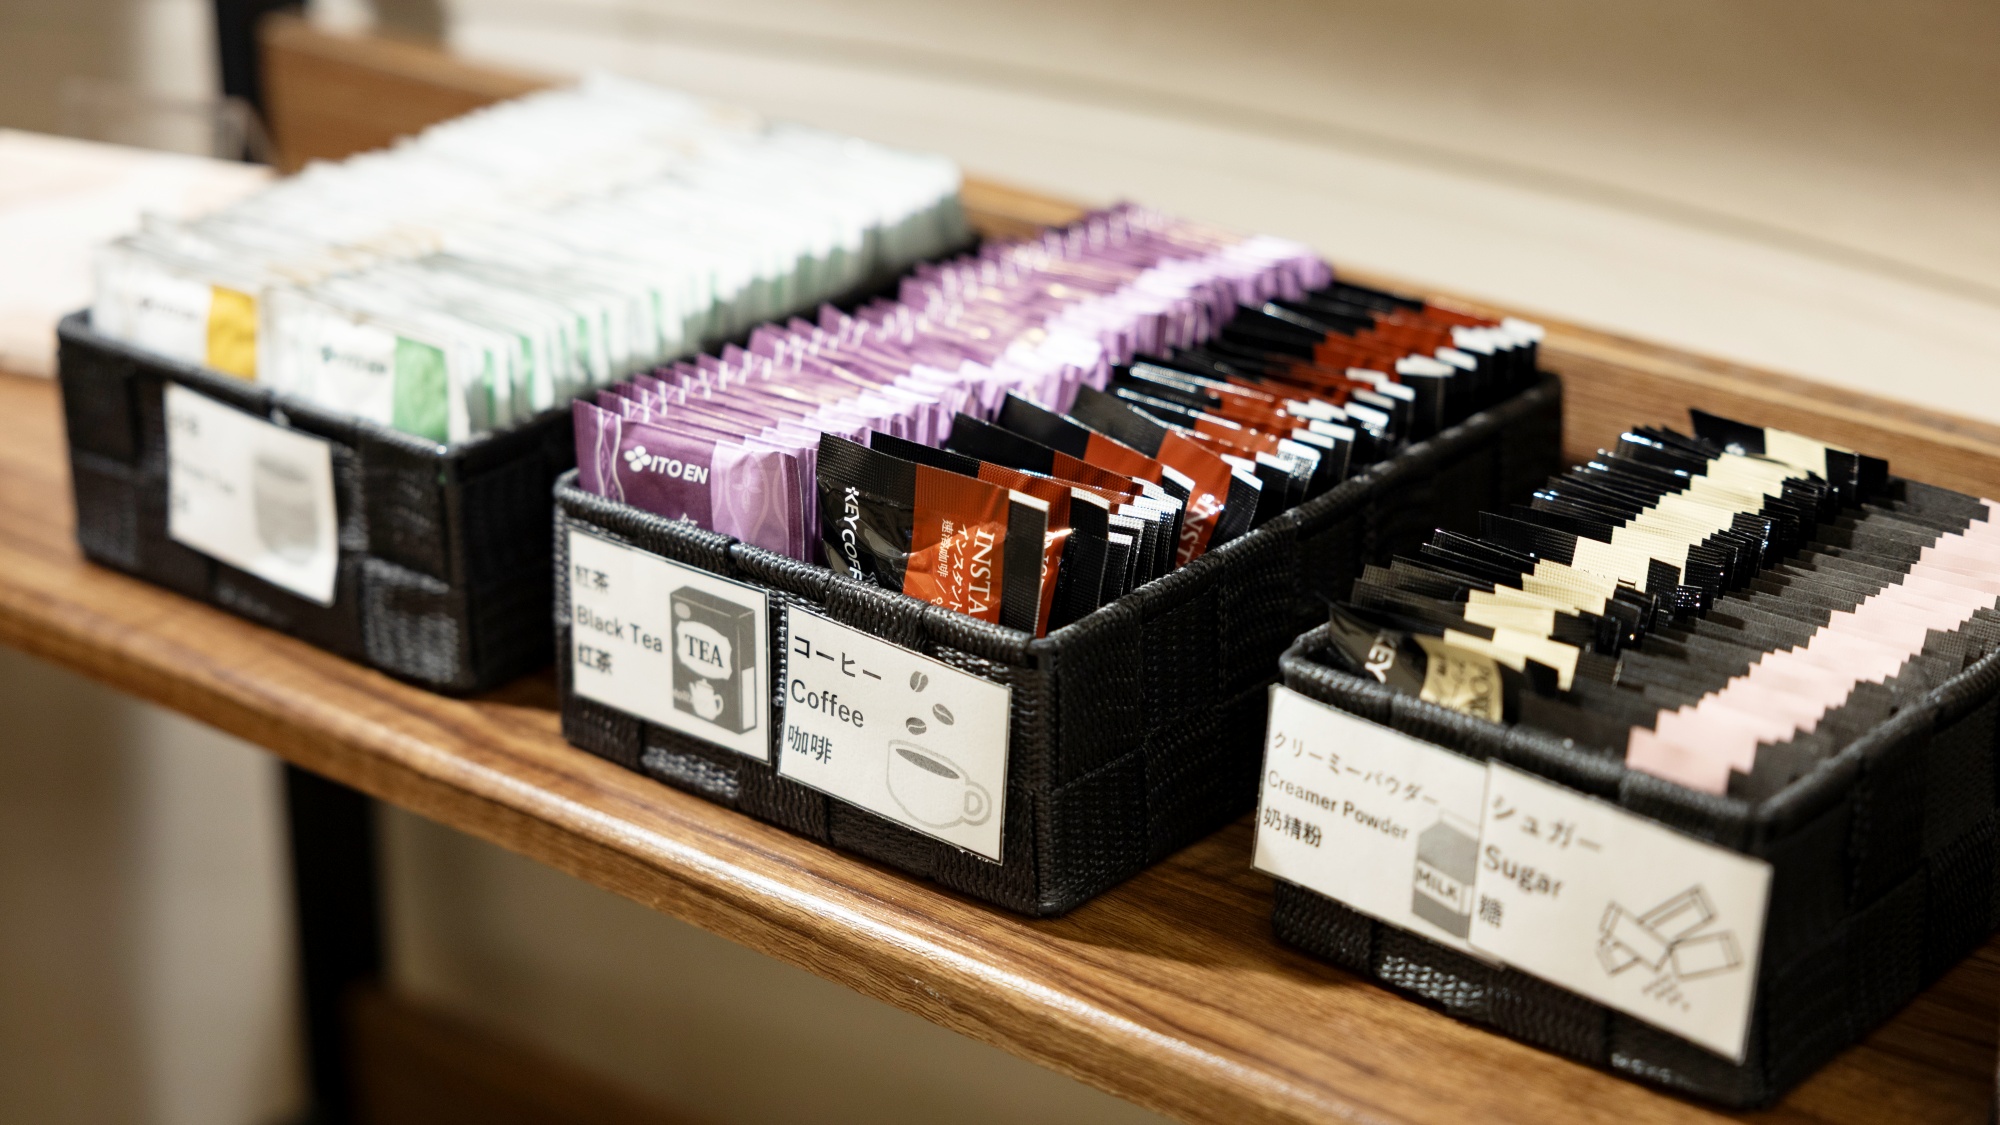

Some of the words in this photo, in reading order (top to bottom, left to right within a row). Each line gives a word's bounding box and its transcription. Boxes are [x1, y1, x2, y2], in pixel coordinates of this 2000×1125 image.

[650, 455, 682, 478] ITO
[682, 464, 709, 485] EN
[968, 528, 995, 617] INSTA
[577, 605, 624, 640] Black
[630, 623, 663, 653] Tea
[685, 634, 724, 668] TEA
[794, 635, 882, 680] コーヒー
[791, 679, 864, 728] Coffee
[788, 725, 833, 764] 咖啡
[1264, 806, 1322, 848] 奶精粉
[1268, 770, 1337, 813] Creamer
[1343, 801, 1408, 839] Powder
[1493, 796, 1603, 851] シュガー
[1416, 867, 1458, 900] MILK
[1483, 844, 1562, 898] Sugar
